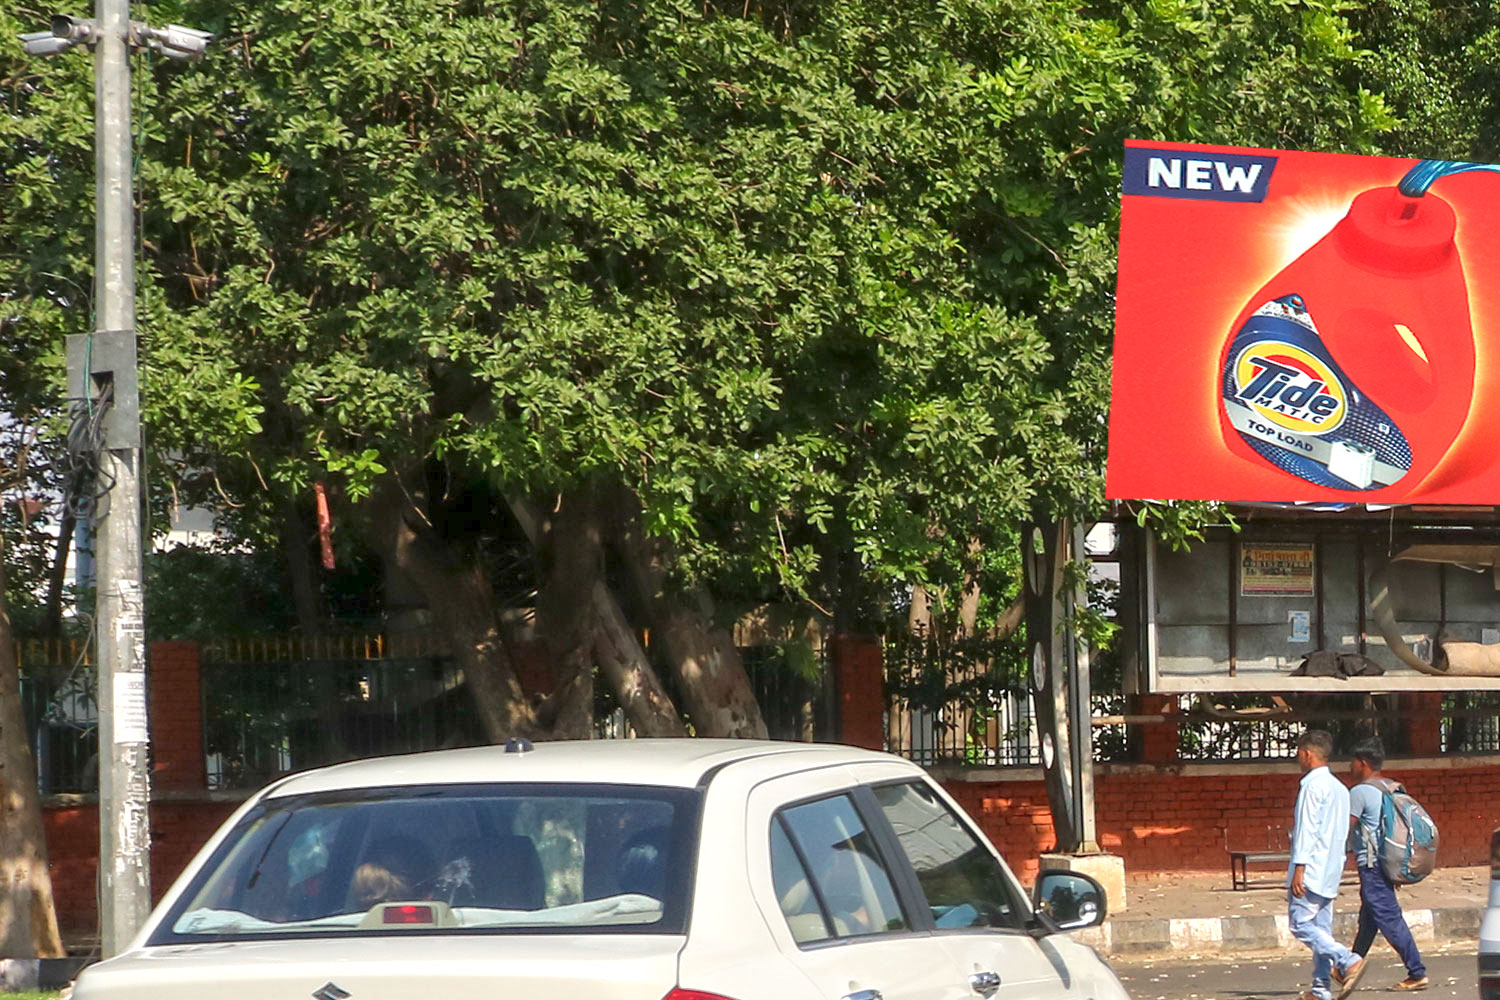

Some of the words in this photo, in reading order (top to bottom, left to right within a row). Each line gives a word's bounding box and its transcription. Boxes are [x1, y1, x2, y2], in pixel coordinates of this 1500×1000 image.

[1148, 157, 1262, 193] NEW
[1237, 357, 1339, 416] Tide
[1254, 397, 1325, 424] MATIC
[1248, 419, 1277, 439] TOP
[1277, 430, 1314, 452] LOAD
